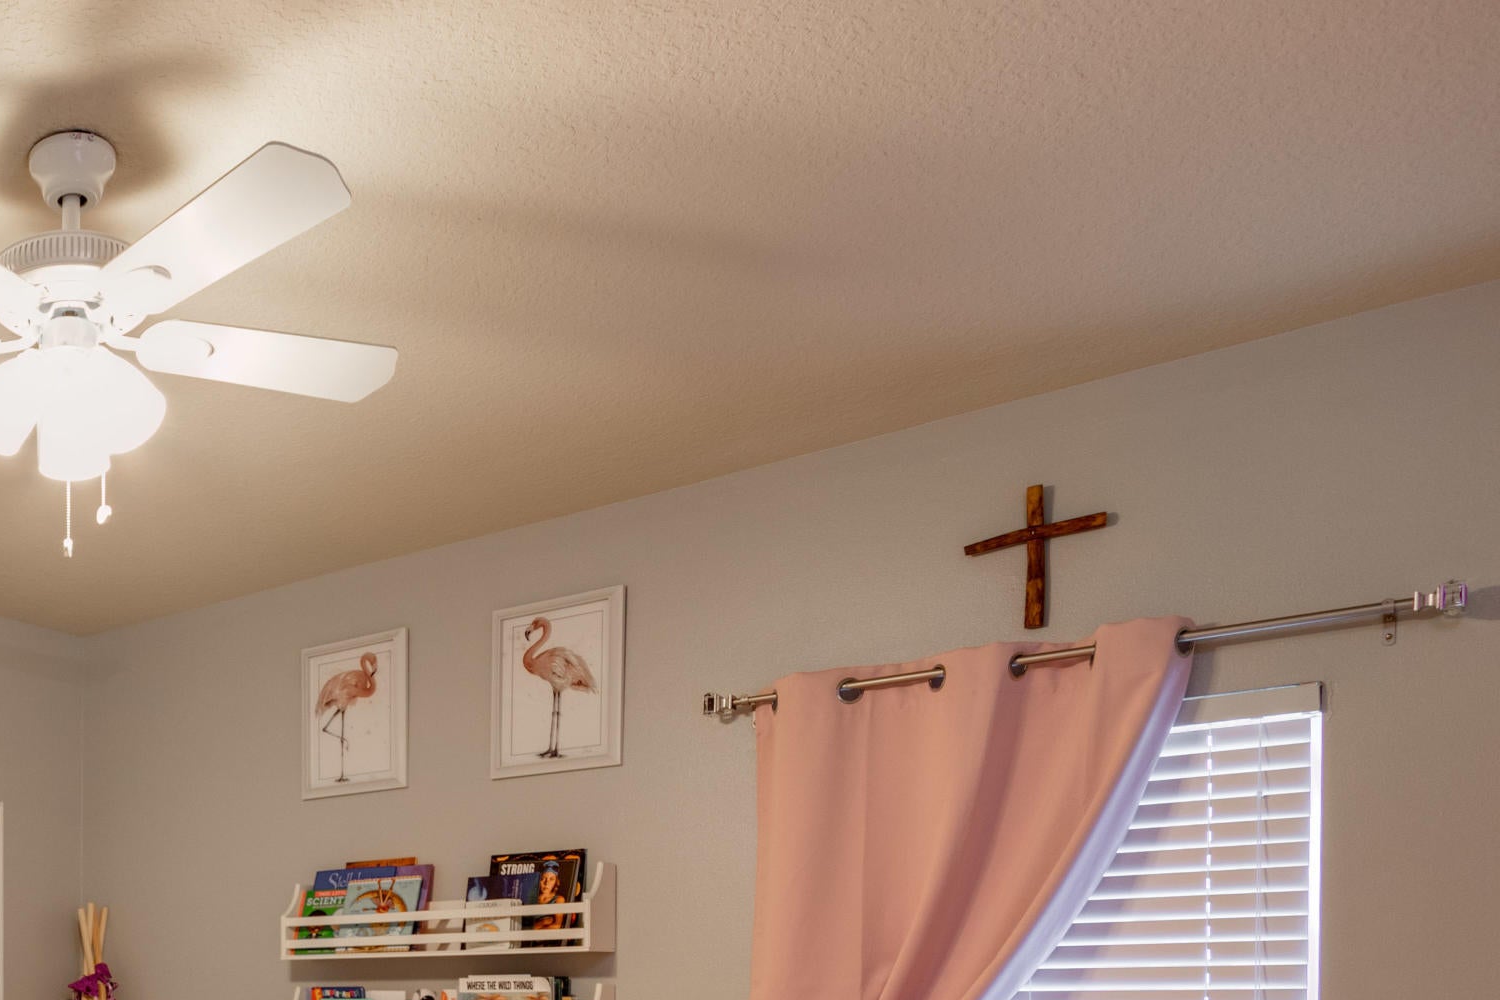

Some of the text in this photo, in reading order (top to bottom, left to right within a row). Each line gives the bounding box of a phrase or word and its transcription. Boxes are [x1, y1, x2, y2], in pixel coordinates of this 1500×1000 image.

[500, 863, 535, 876] STRONG
[306, 895, 346, 906] SCIENT
[466, 980, 534, 990] WHERE THE WILD THINGS
